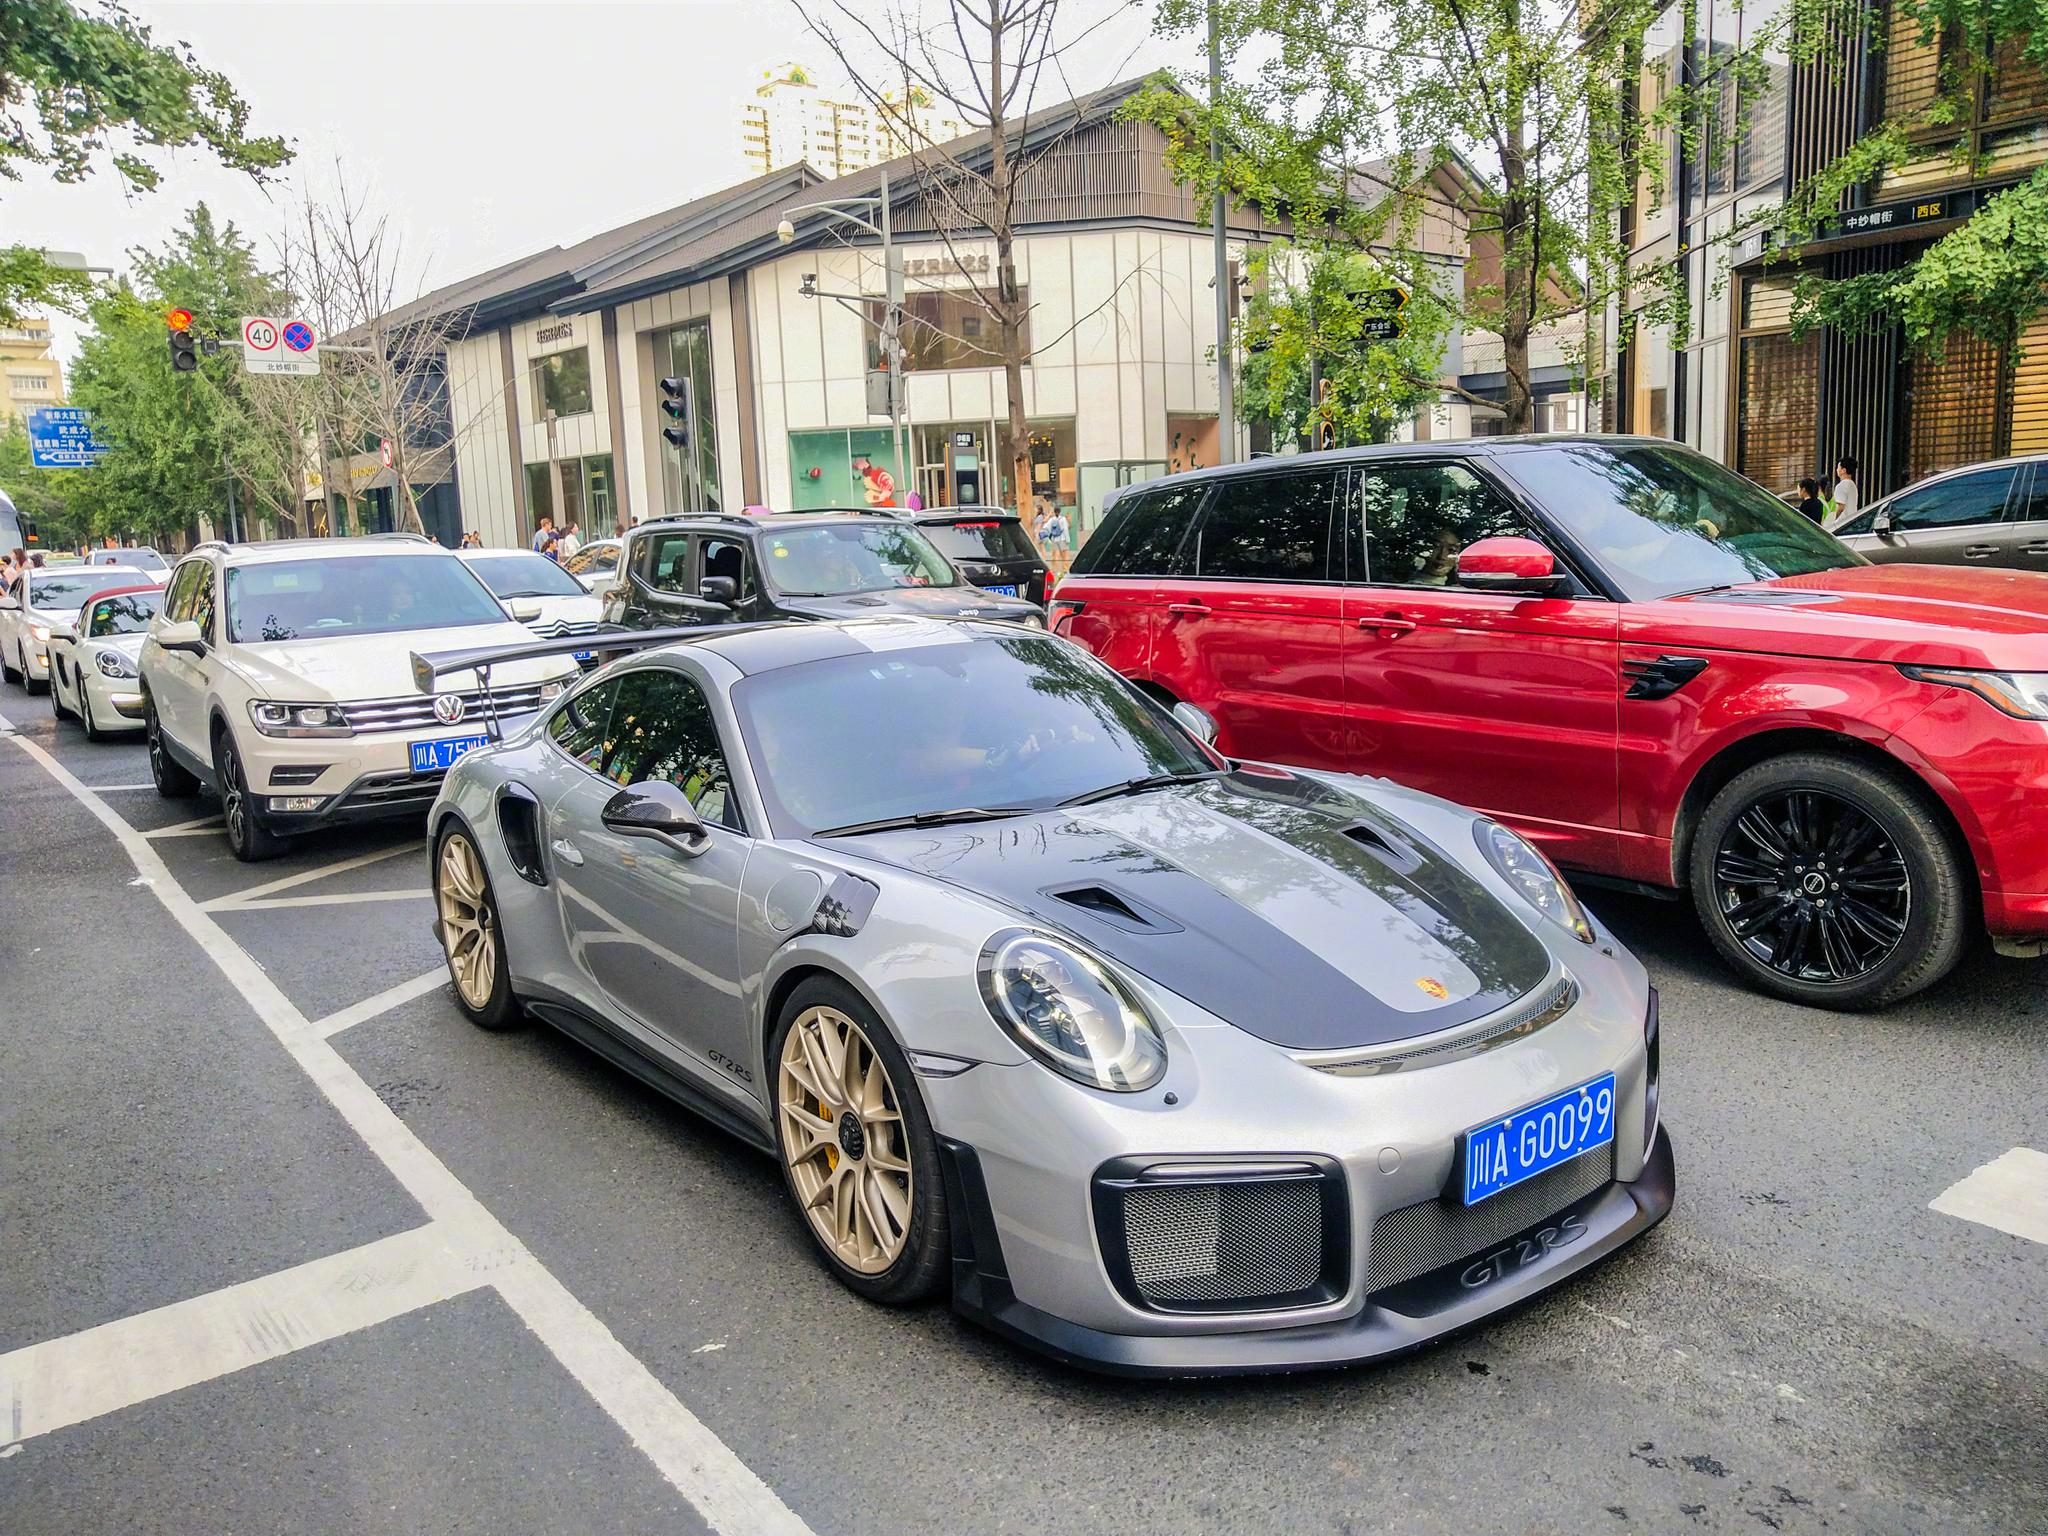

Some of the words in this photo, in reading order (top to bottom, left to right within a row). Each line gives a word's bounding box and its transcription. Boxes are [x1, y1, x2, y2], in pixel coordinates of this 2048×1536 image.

[1847, 211, 1893, 229] 中纱帽街
[1917, 203, 1941, 218] 西区
[253, 328, 272, 343] 40
